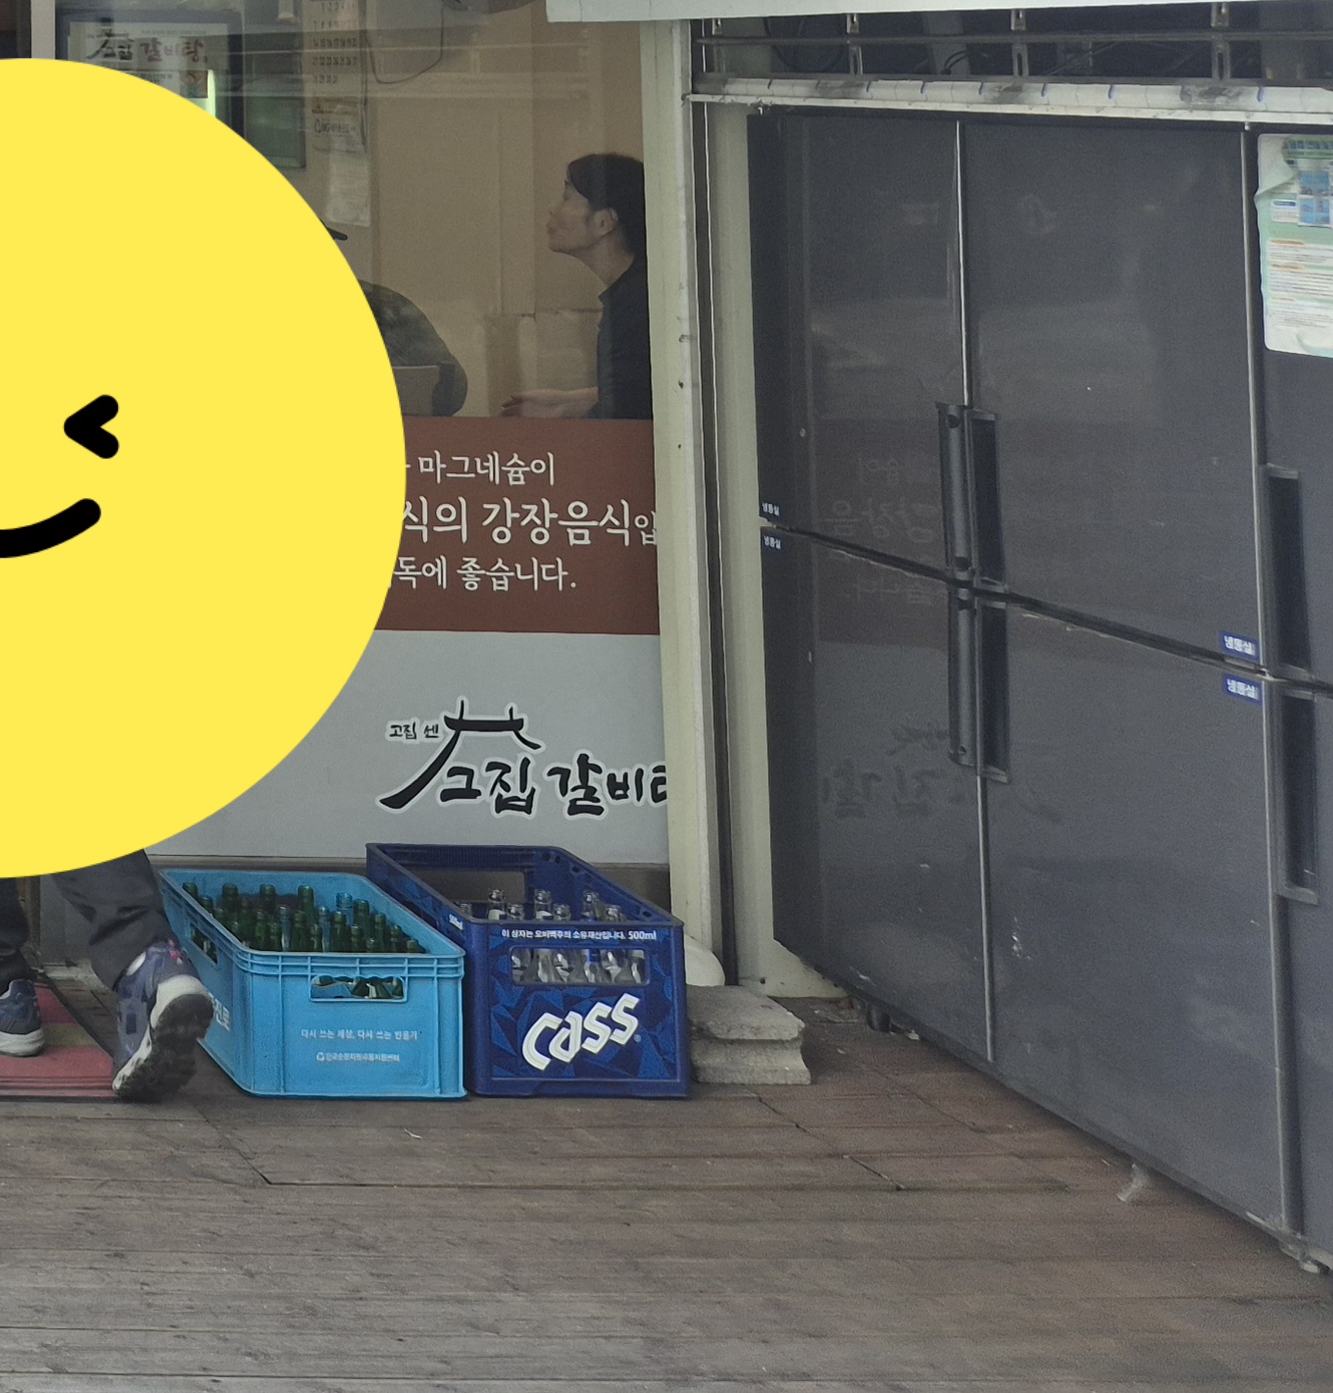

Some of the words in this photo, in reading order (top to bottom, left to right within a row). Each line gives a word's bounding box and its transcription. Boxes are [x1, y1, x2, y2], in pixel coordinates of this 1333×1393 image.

[418, 450, 555, 486] 마그네슘이
[389, 555, 448, 590] 독에
[456, 557, 577, 592] 좋습니다.
[389, 722, 418, 740] 고집
[424, 723, 440, 739] 센
[439, 756, 536, 816] 그집
[627, 928, 657, 940] 500ml
